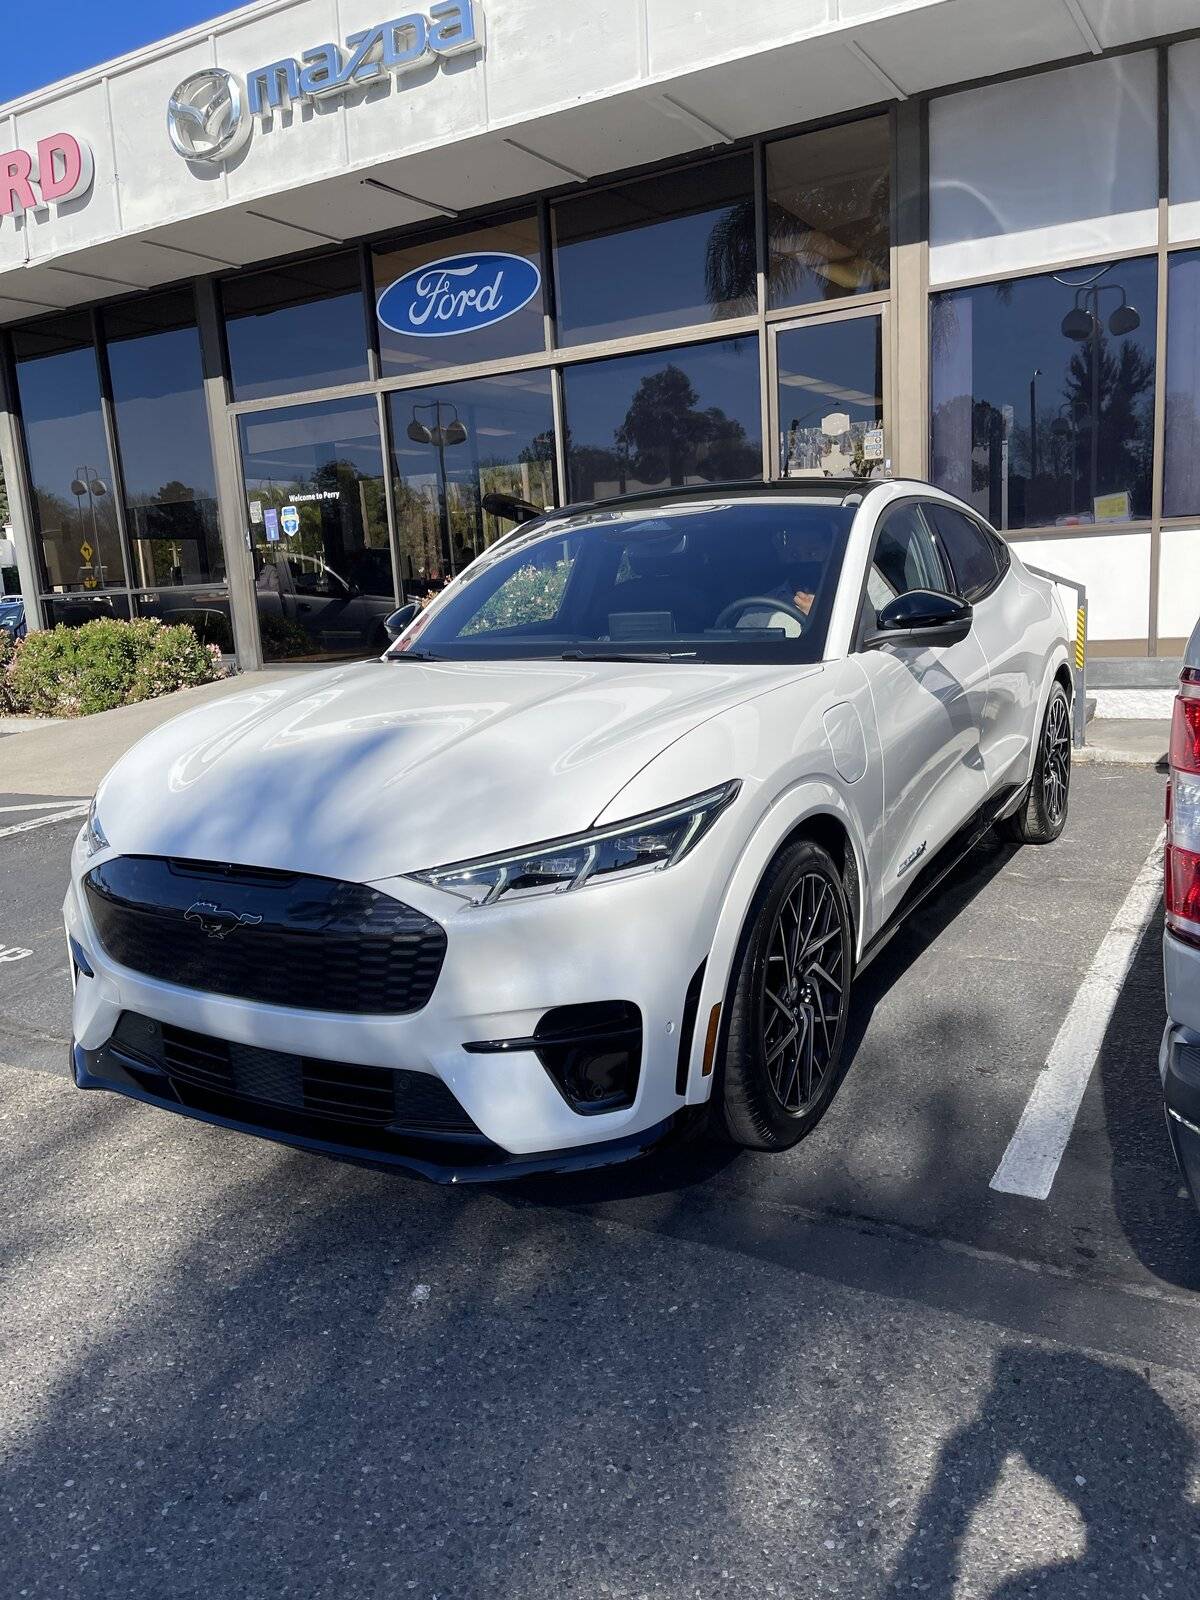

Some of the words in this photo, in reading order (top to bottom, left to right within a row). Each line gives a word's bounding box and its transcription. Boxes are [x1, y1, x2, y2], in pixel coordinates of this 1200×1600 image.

[408, 263, 504, 326] Ford
[288, 493, 316, 502] Welcome
[315, 492, 323, 500] to
[323, 490, 340, 500] Perry
